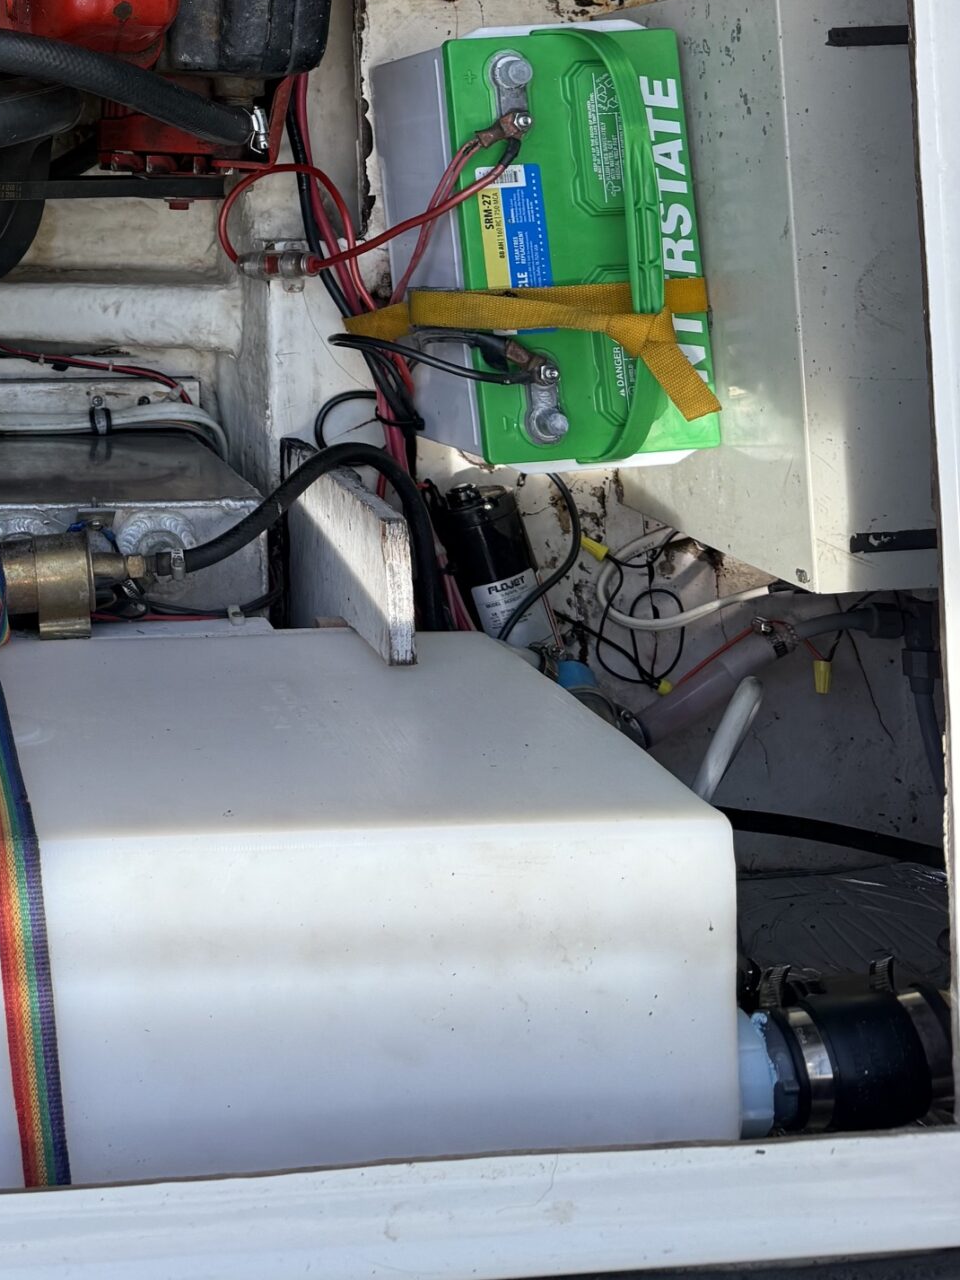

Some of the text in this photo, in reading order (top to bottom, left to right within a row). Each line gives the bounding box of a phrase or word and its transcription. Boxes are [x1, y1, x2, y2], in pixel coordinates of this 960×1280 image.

[481, 193, 494, 229] SRM-27
[498, 241, 504, 249] AH
[518, 230, 526, 263] REPLACEMENT
[613, 346, 624, 386] DANGER
[487, 575, 524, 594] FLOJET
